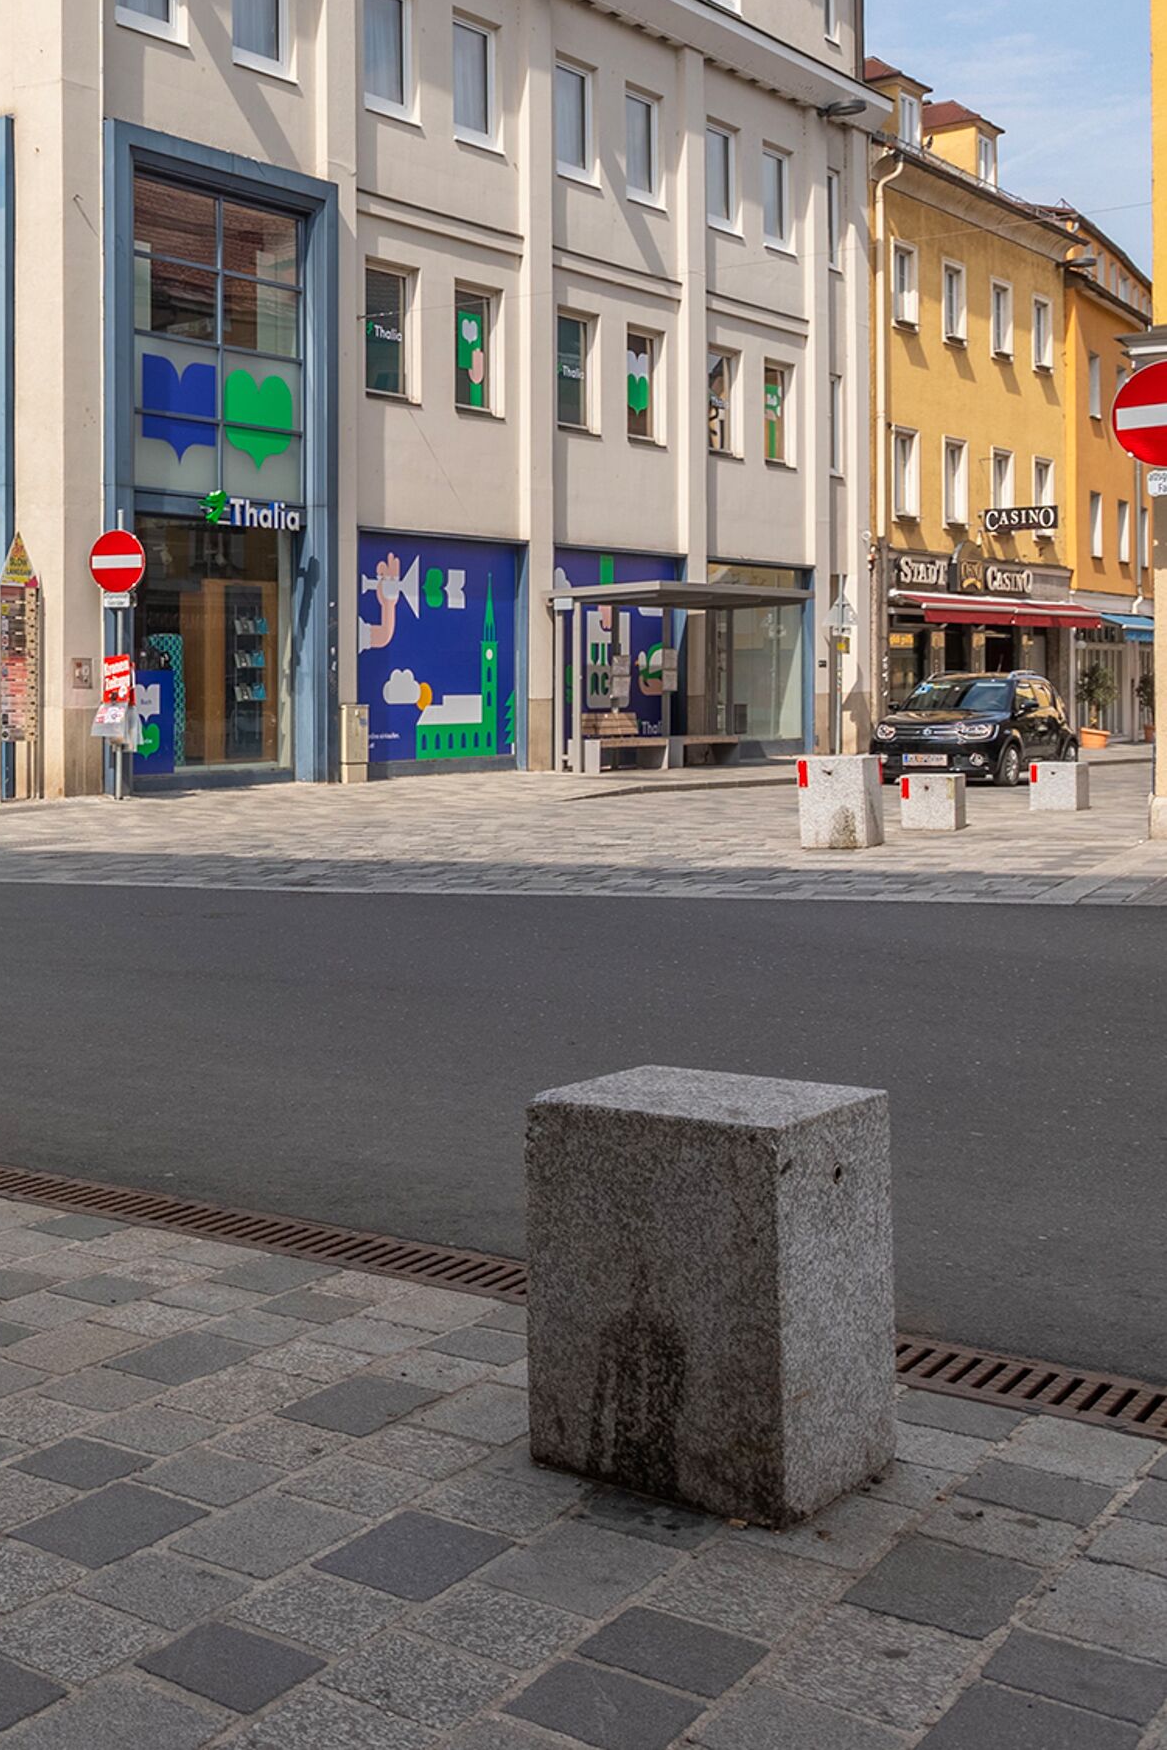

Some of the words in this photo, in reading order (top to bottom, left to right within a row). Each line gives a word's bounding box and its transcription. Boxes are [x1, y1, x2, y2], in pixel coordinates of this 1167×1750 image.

[374, 324, 402, 342] Thalia
[230, 497, 300, 531] Thalia
[985, 506, 1055, 531] CASINO
[900, 556, 948, 585] STADT
[986, 566, 1033, 593] CASINO
